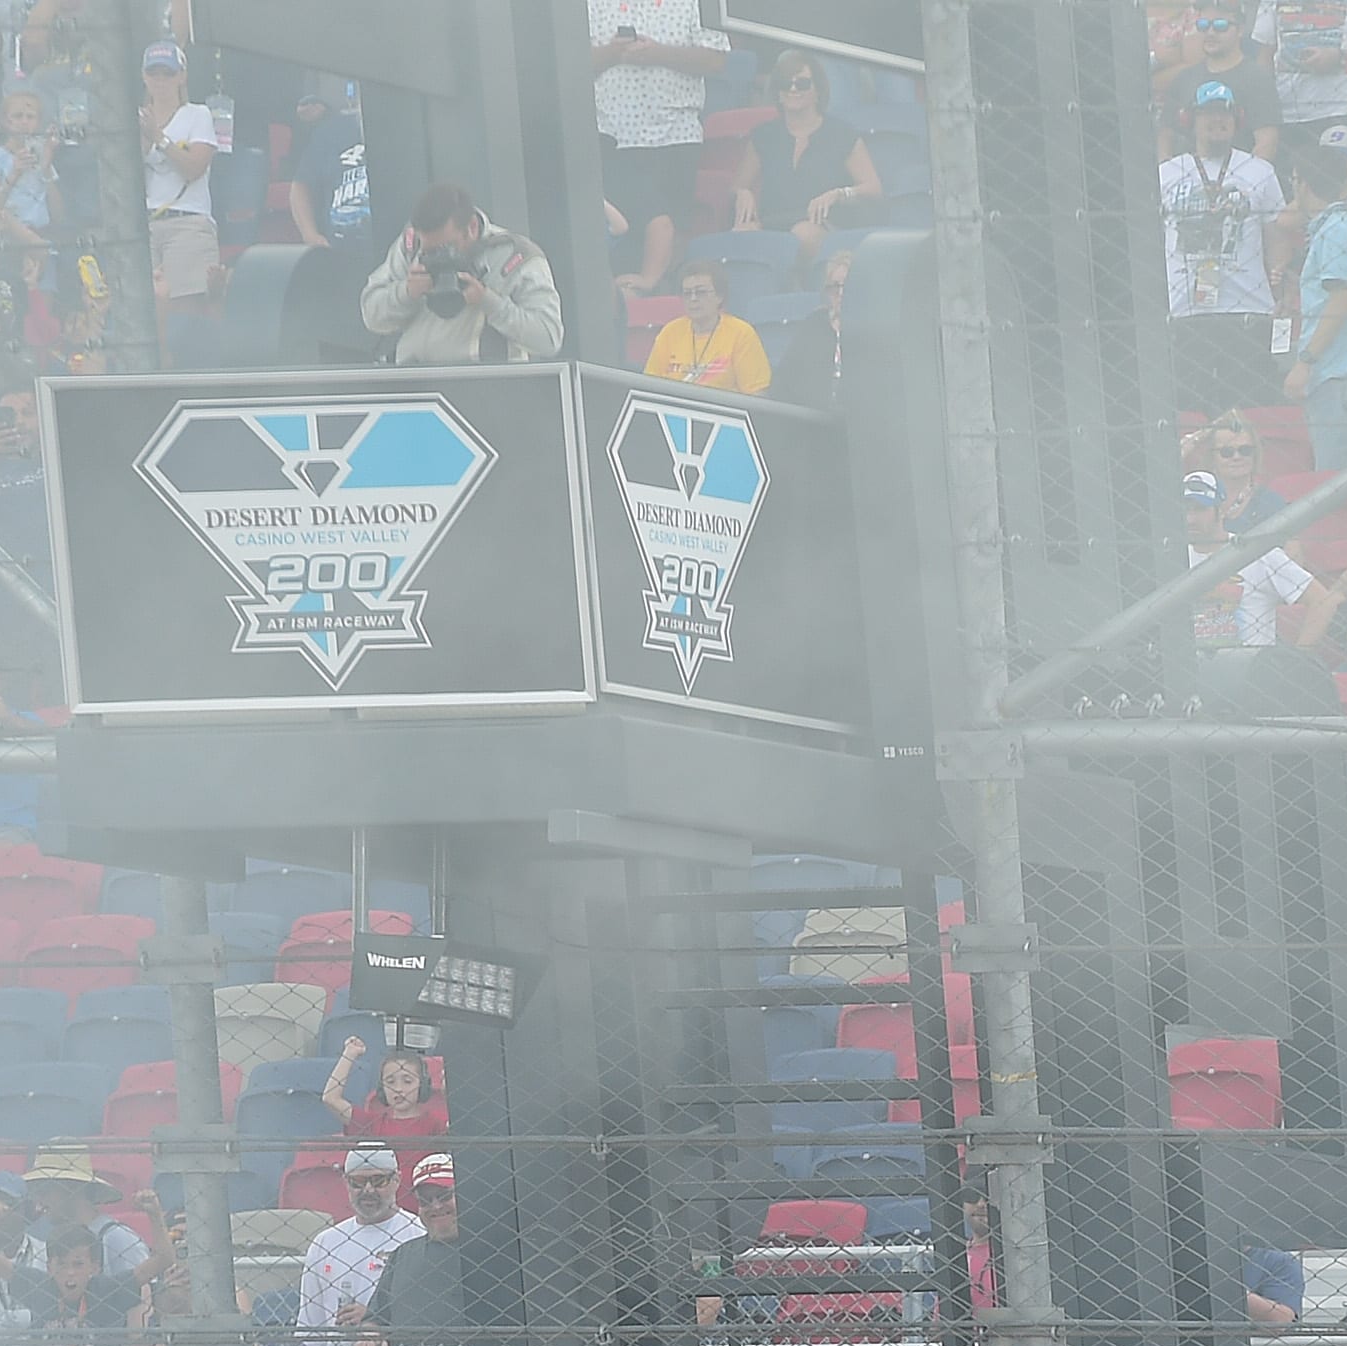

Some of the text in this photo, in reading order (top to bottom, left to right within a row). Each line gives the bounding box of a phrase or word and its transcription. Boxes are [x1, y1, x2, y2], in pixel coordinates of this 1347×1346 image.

[205, 503, 438, 528] DESERT DIAMOND
[636, 502, 742, 538] DESERT DIAMOND
[235, 528, 410, 546] CASINO WEST VALLEY
[648, 529, 676, 547] CASINO
[677, 534, 700, 550] WEST
[266, 552, 391, 594] 200
[661, 554, 718, 600] 200
[267, 614, 396, 630] AT ISM RACEWAY
